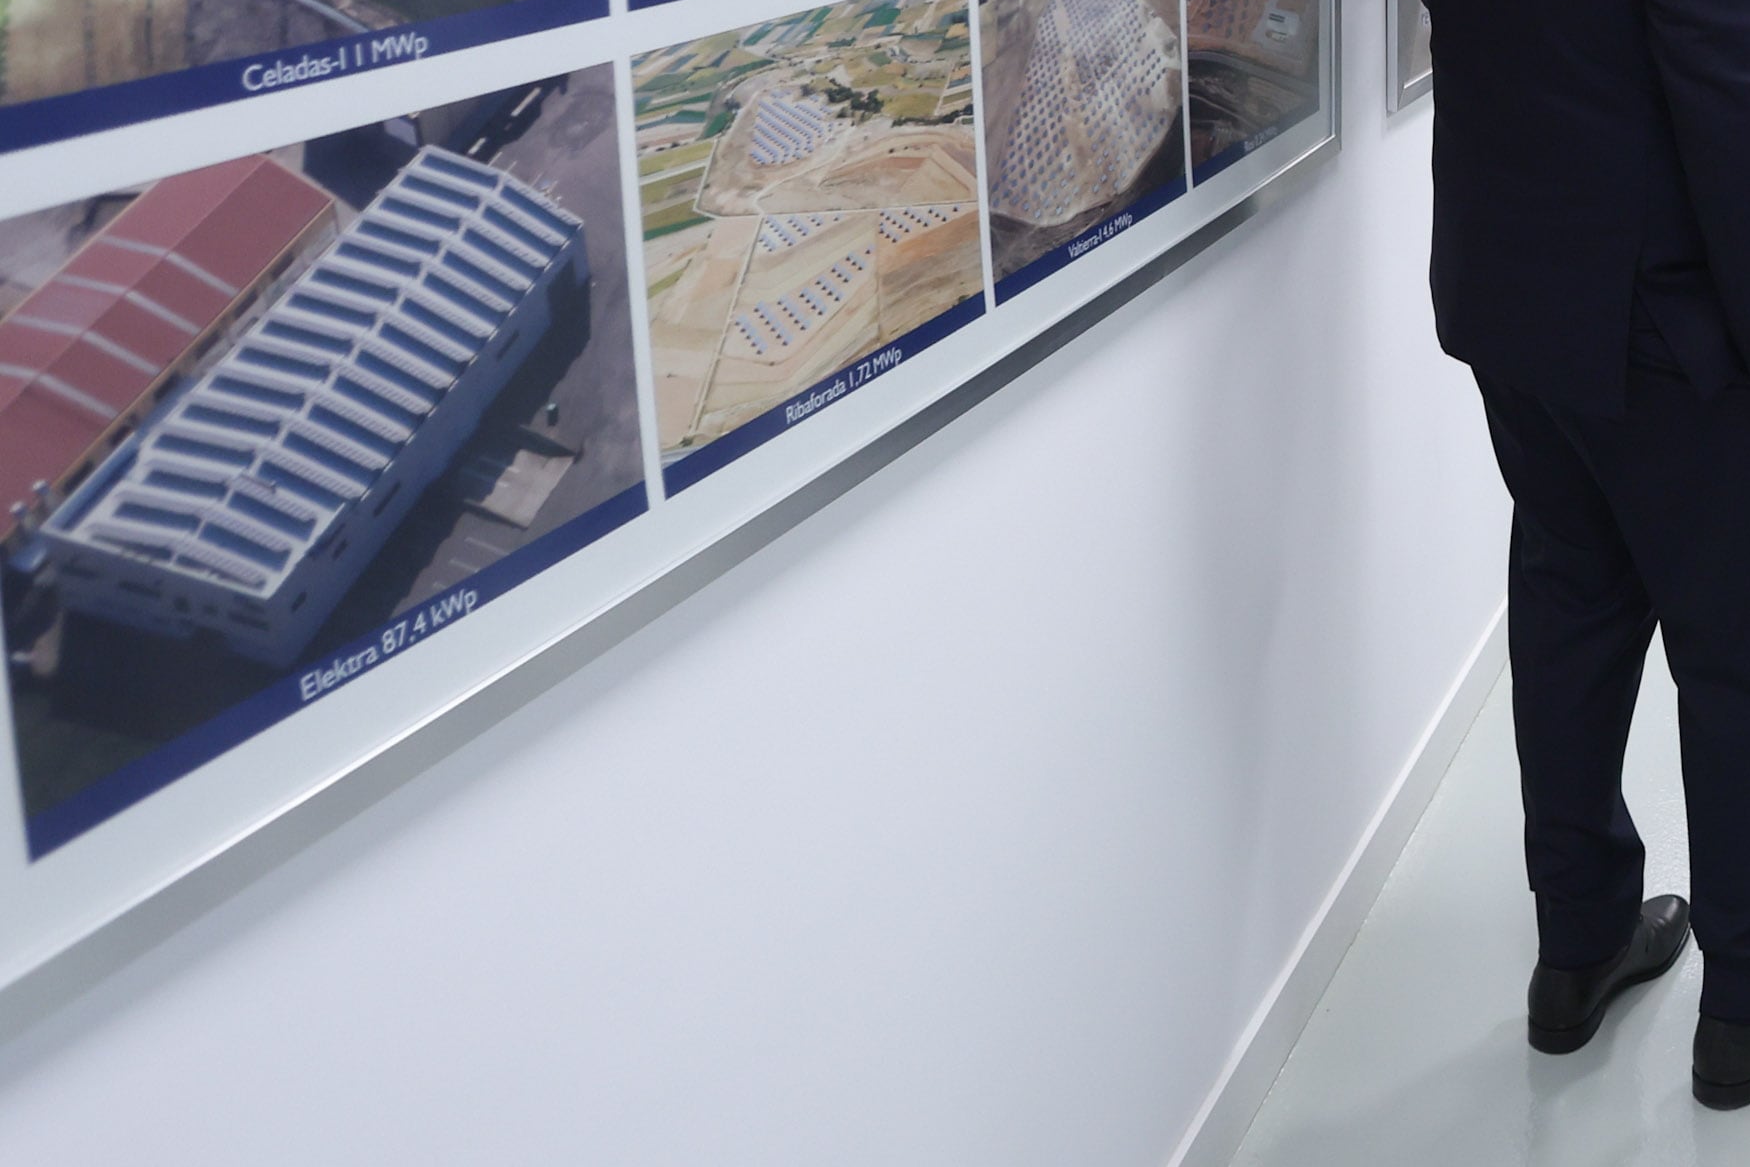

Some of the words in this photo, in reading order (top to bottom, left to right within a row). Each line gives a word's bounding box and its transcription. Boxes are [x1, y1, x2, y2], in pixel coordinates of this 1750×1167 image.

[242, 46, 347, 92] Celadas-I
[371, 32, 430, 60] MWp
[1114, 212, 1133, 233] MWp
[785, 379, 847, 425] Ribaforada
[849, 361, 872, 388] 1,72
[873, 346, 903, 375] MWp
[300, 645, 380, 701] Elektra
[430, 588, 478, 626] kWp
